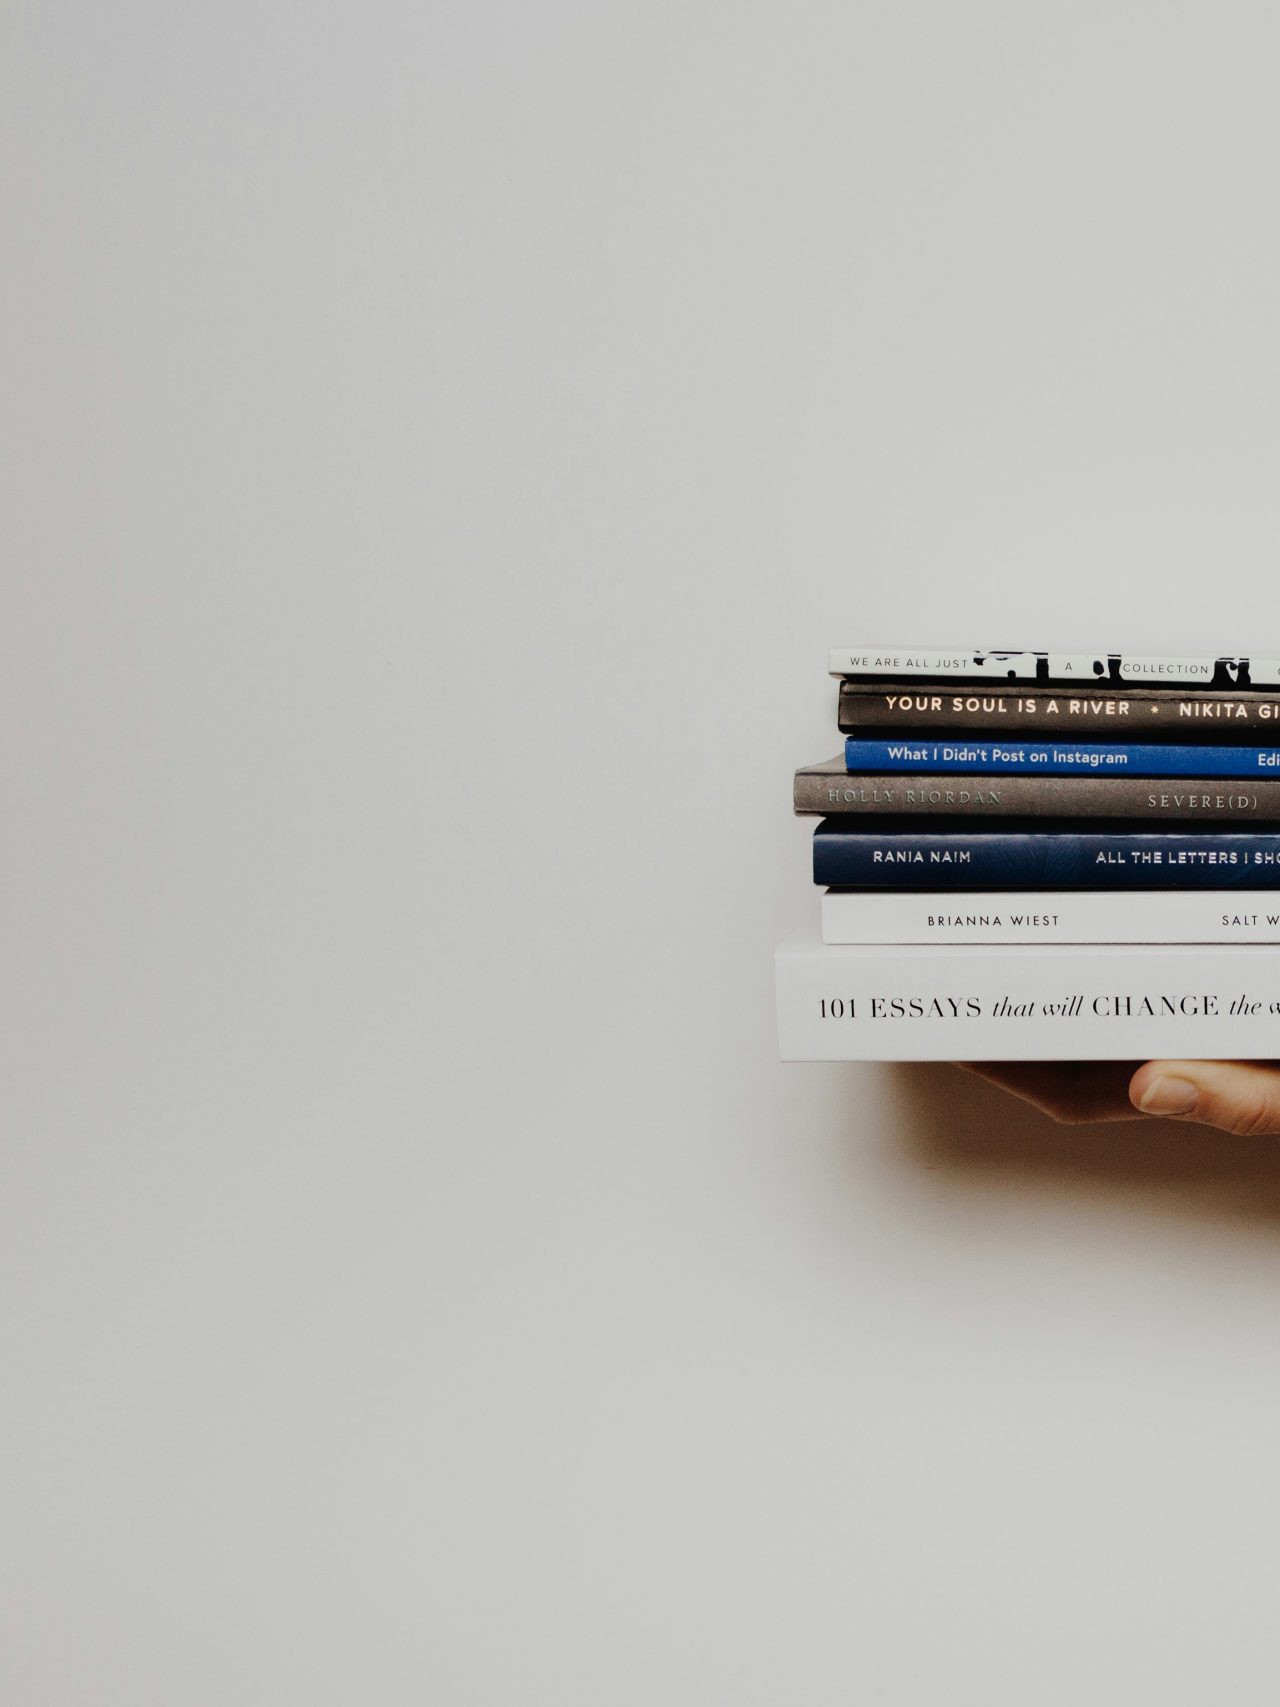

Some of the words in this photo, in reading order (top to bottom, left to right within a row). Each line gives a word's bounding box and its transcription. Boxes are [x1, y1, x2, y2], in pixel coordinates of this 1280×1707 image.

[850, 657, 868, 667] WE
[874, 657, 900, 667] ARE
[905, 658, 929, 668] ALL
[935, 659, 968, 669] JUST
[1063, 662, 1074, 672] A
[1122, 663, 1209, 675] COLLECTION
[885, 696, 942, 711] YOUR
[952, 697, 1008, 713] SOUL
[1018, 698, 1037, 714] IS
[1045, 699, 1060, 715] A
[1069, 700, 1130, 715] RIVER
[1179, 702, 1248, 718] NIKITA
[887, 746, 928, 761] What
[933, 747, 938, 761] I
[943, 747, 988, 762] Didn't
[992, 748, 1025, 762] Post
[1029, 752, 1048, 763] on
[1053, 749, 1128, 767] Instagram
[827, 788, 895, 803] HOLLY
[905, 789, 1002, 805] RIORDAN
[1147, 794, 1259, 810] SEVERE(D)
[873, 850, 924, 863] RANIA
[930, 850, 971, 863] NAIM
[1095, 851, 1126, 864] ALL
[1131, 851, 1163, 864] THE
[1168, 851, 1238, 864] LETTERS
[1244, 852, 1248, 865] I
[927, 915, 1002, 927] BRIANNA
[1010, 915, 1059, 926] WIEST
[1222, 915, 1258, 926] SALT
[818, 998, 857, 1019] 101
[871, 997, 981, 1018] ESSAYS
[992, 996, 1035, 1017] that
[1042, 995, 1084, 1017] will
[1092, 995, 1219, 1016] CHANGE
[1229, 994, 1262, 1016] the
